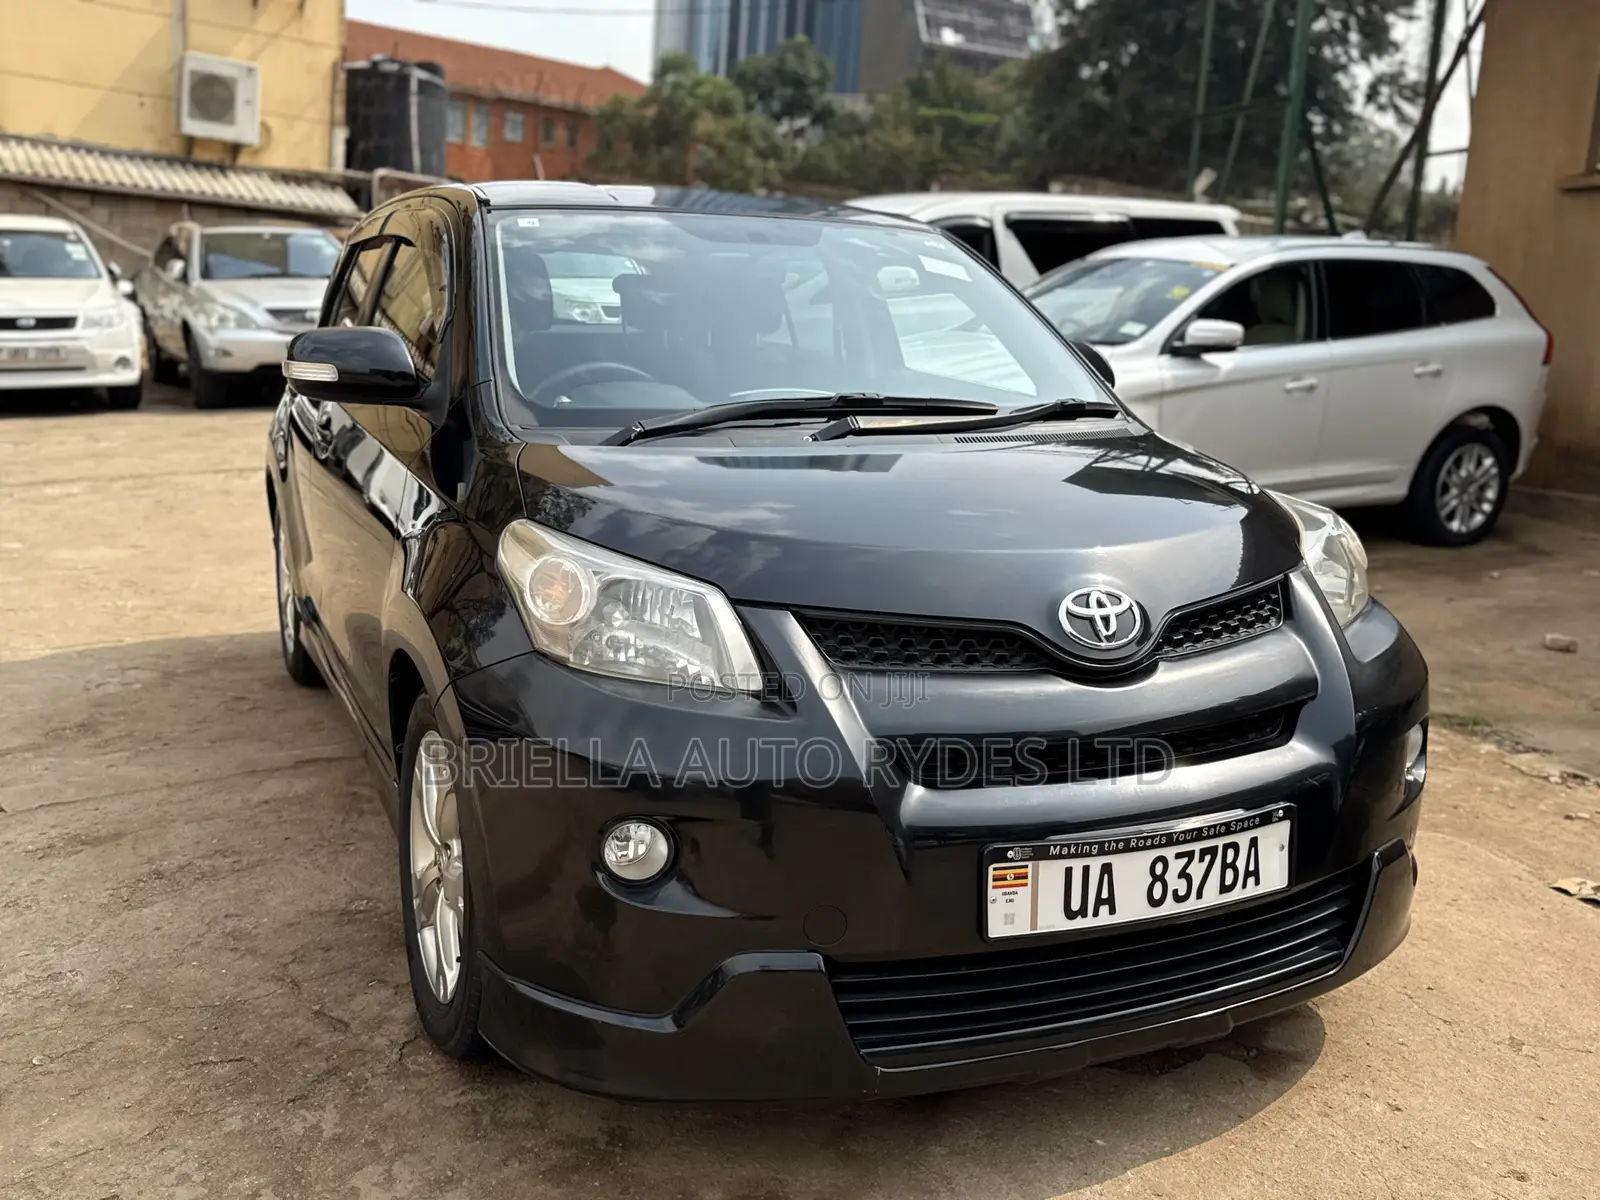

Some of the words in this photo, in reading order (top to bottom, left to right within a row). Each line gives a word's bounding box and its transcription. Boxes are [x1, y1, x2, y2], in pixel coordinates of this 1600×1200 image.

[1049, 844, 1099, 856] Making
[1104, 840, 1124, 851] the
[1129, 835, 1167, 848] Roads
[1172, 829, 1197, 842] Your
[1202, 825, 1226, 837] Safe
[1230, 817, 1260, 831] Space
[1063, 862, 1117, 921] UA
[1146, 835, 1261, 908] 837BA
